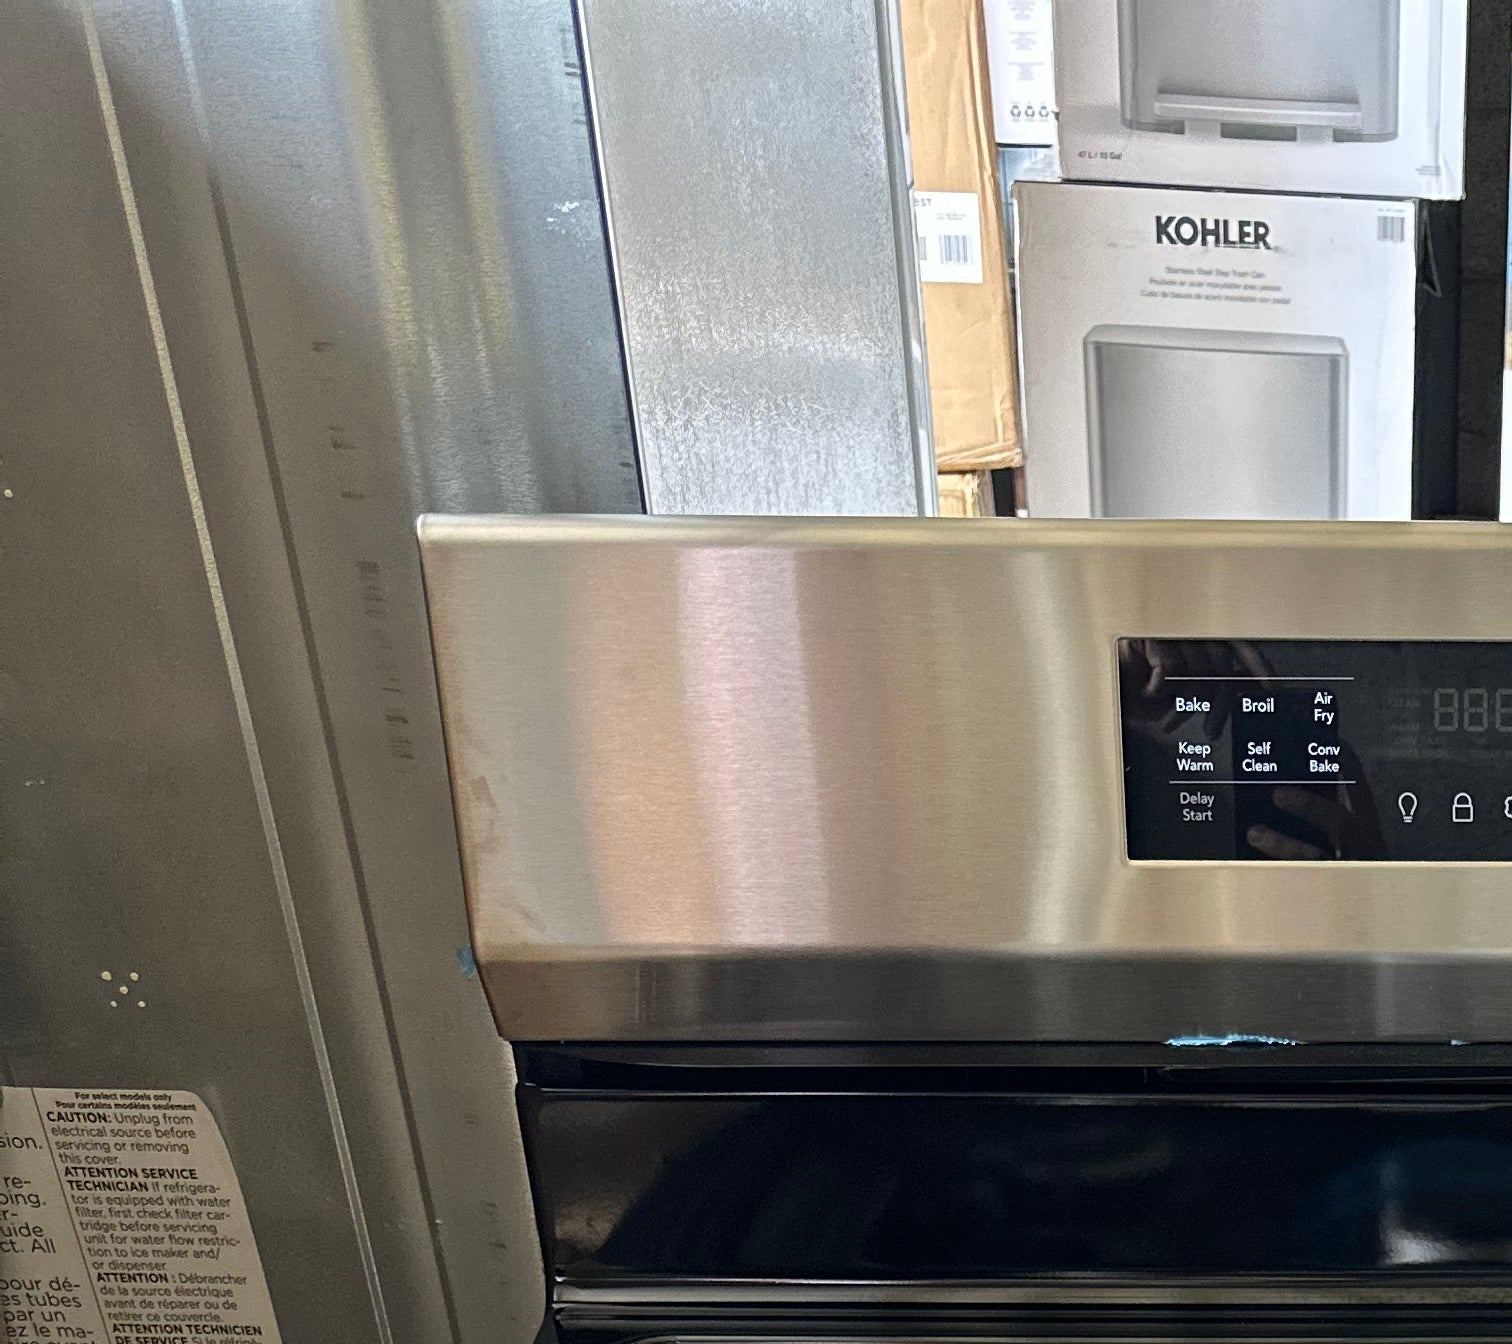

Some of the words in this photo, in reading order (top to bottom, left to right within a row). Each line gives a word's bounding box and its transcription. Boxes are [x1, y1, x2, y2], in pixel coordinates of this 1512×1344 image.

[1155, 215, 1272, 250] KOHLER
[1175, 697, 1211, 712] Bake
[1242, 697, 1275, 713] Broil
[1314, 692, 1333, 704] Air
[1314, 709, 1335, 725] Fry
[1178, 742, 1211, 758] Keep
[1247, 742, 1272, 755] Self
[1307, 743, 1340, 756] Conv
[1177, 759, 1214, 771] Warm
[1242, 759, 1278, 772] Clean
[1309, 759, 1340, 773] Bake
[1179, 792, 1215, 807] Delay
[1182, 809, 1213, 821] Start
[46, 1111, 112, 1123] CAUTION:
[114, 1112, 160, 1126] Unplug
[162, 1113, 193, 1125] from
[51, 1126, 107, 1138] electrical
[110, 1128, 152, 1138] source
[155, 1128, 197, 1139] before
[55, 1140, 111, 1153] servicing
[114, 1142, 127, 1151] or
[130, 1142, 190, 1154] removing
[59, 1152, 83, 1164] this
[64, 1166, 139, 1179] ATTENTION
[141, 1168, 198, 1180] SERVICE
[67, 1180, 149, 1192] TECHNICIAN
[163, 1183, 221, 1195] refrigera-
[71, 1194, 91, 1206] tor
[106, 1196, 165, 1209] equipped
[168, 1195, 193, 1207] with
[197, 1198, 231, 1208] water
[108, 1207, 133, 1219] first
[136, 1208, 172, 1220] check
[174, 1208, 203, 1220] filter
[79, 1220, 116, 1233] tridge
[119, 1221, 160, 1233] before
[163, 1223, 218, 1235] servicing
[31, 1238, 56, 1254] All
[84, 1233, 108, 1245] unit
[110, 1233, 128, 1245] for
[131, 1235, 165, 1246] water
[168, 1235, 195, 1246] flow
[87, 1246, 113, 1258] tion
[152, 1247, 189, 1259] maker
[49, 1277, 80, 1292] dé-
[97, 1272, 168, 1283] ATTENTION
[179, 1273, 247, 1285] Débrancher
[100, 1286, 115, 1297] de
[131, 1288, 171, 1298] source
[174, 1286, 234, 1299] électrique
[27, 1293, 82, 1308] tubes
[4, 1310, 35, 1324] par
[41, 1311, 66, 1322] un
[34, 1323, 51, 1338] le
[57, 1326, 94, 1339] ma-
[113, 1323, 183, 1335] ATTENTION
[186, 1325, 262, 1336] TECHNICIEN
